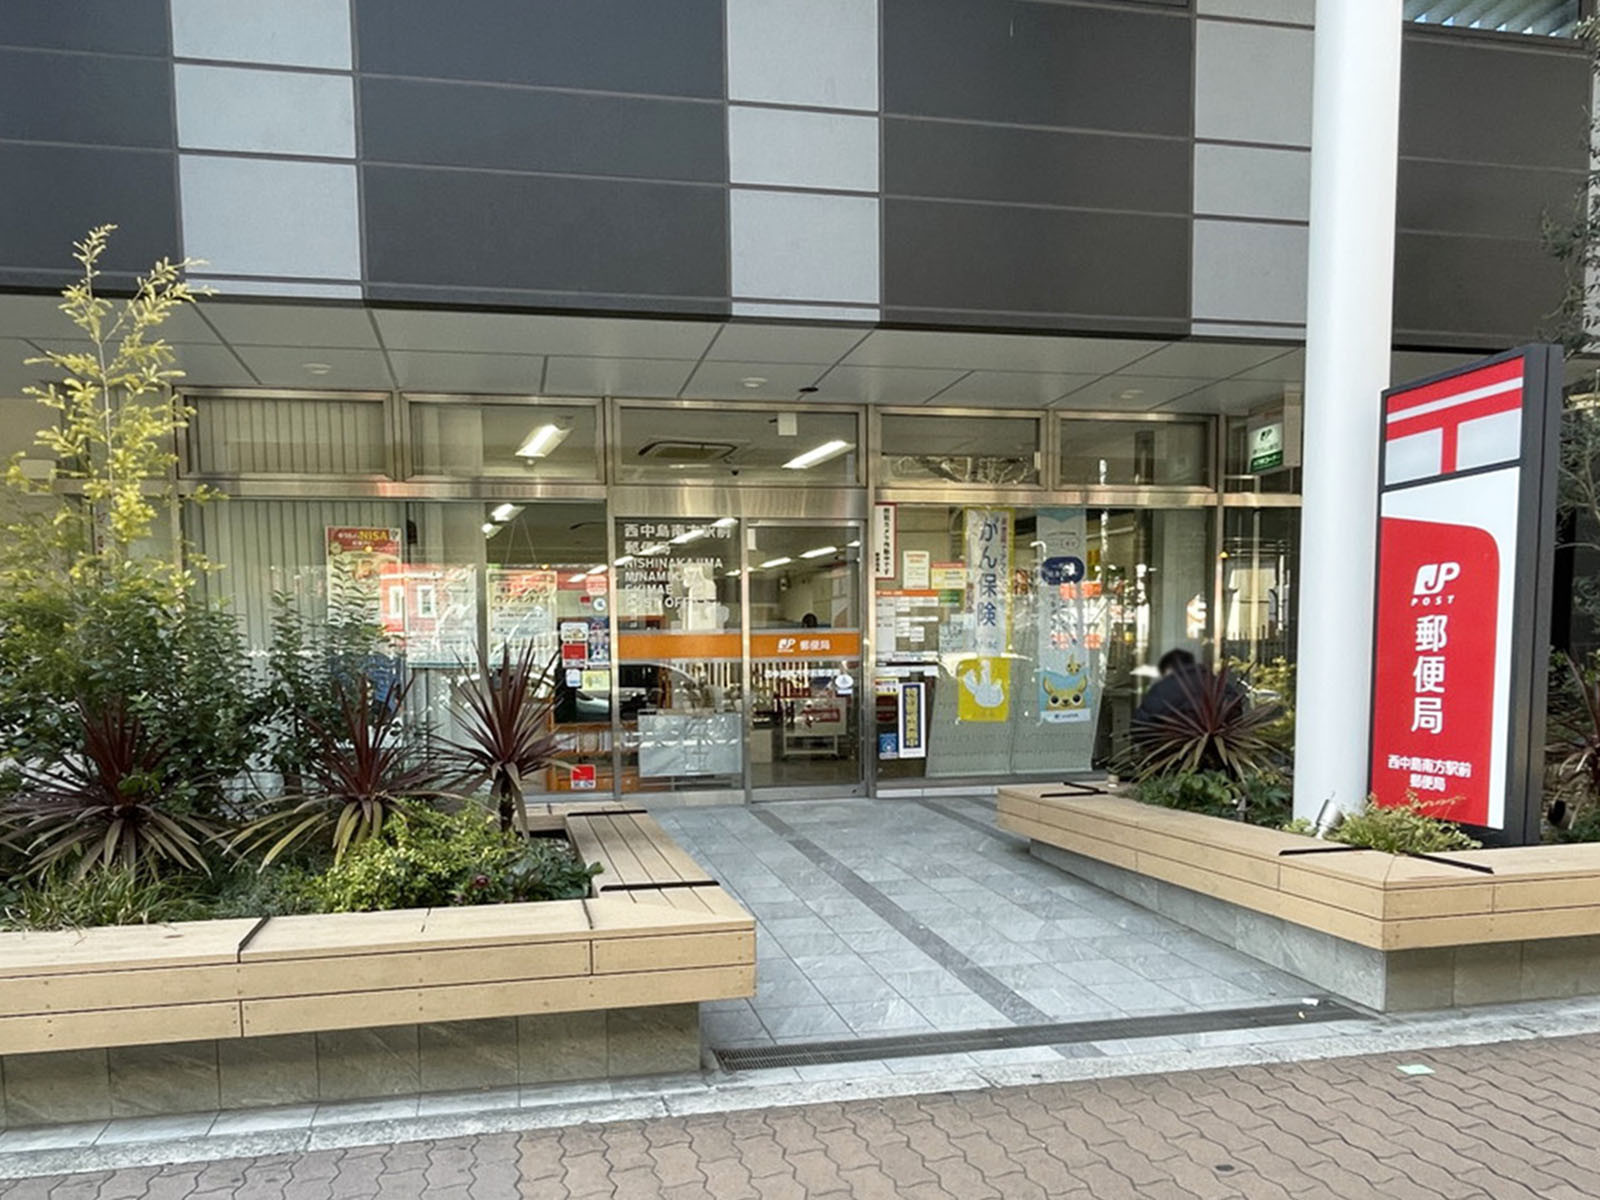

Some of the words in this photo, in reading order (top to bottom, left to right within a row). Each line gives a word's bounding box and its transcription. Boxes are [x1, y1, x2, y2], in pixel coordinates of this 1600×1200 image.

[977, 517, 998, 626] がん保険
[1412, 562, 1461, 595] JP
[1410, 595, 1455, 607] POST
[1411, 615, 1448, 734] 郵便局
[1388, 754, 1472, 778] 西中島南方駅前
[1410, 773, 1446, 792] 郵便局
